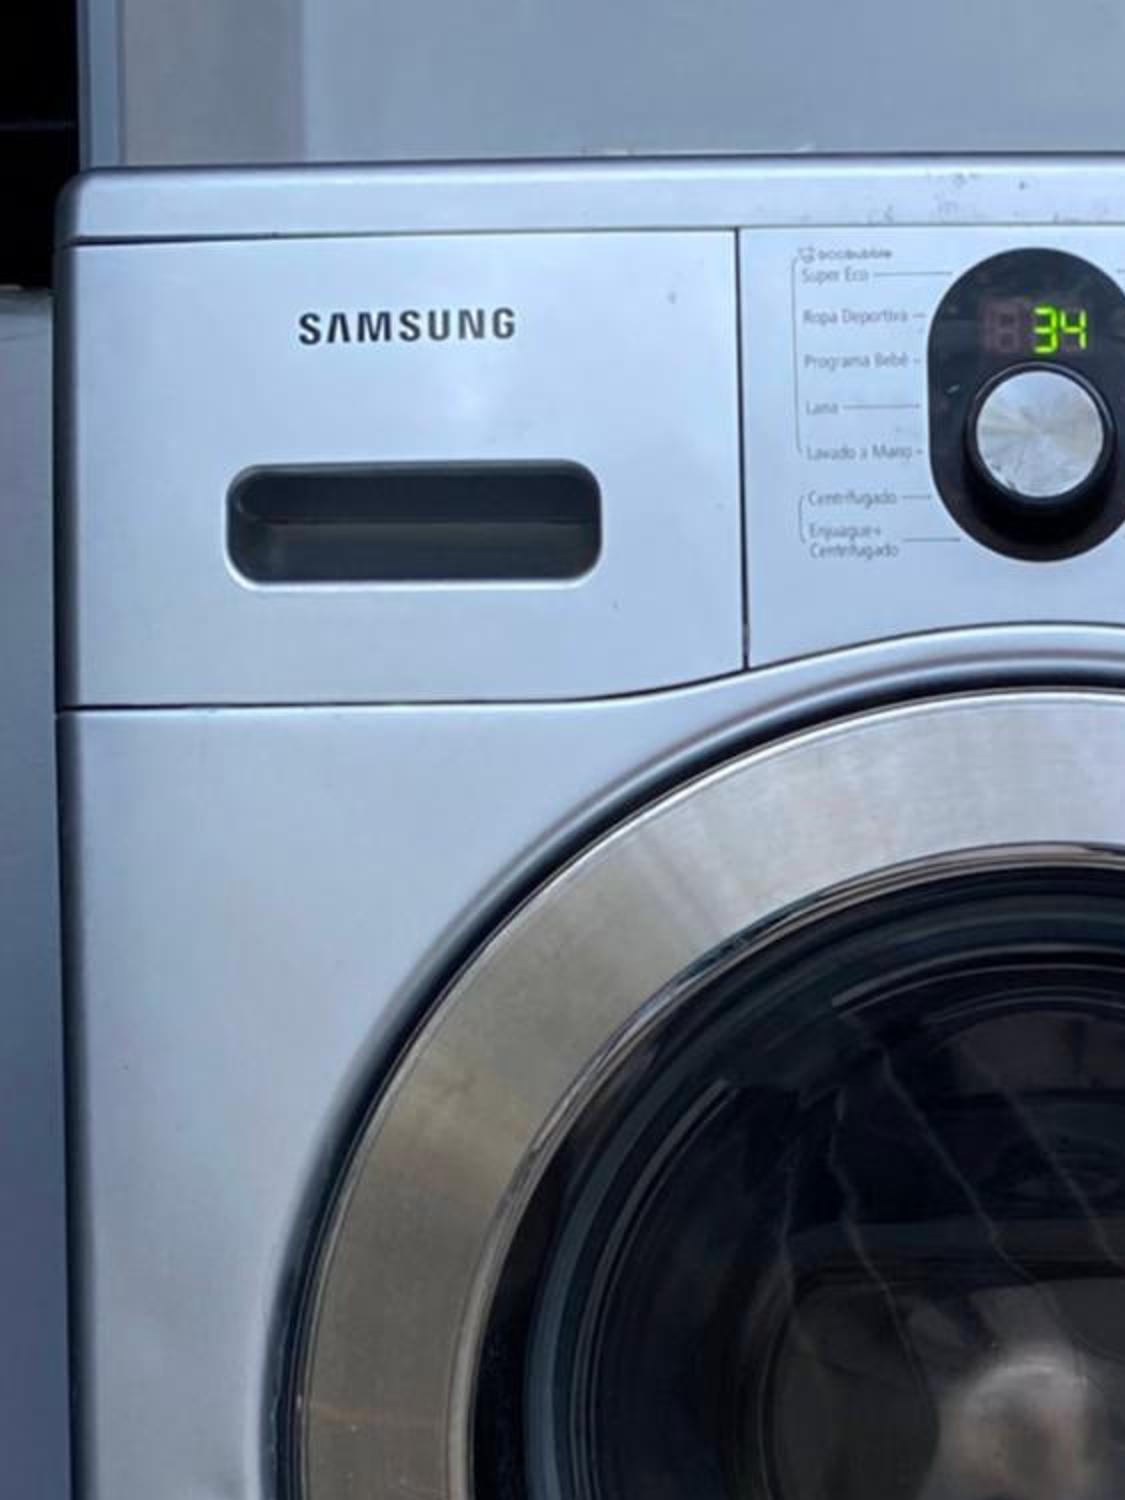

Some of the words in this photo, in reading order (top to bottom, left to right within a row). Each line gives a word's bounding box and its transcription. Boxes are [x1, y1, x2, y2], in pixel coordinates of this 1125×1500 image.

[801, 267, 840, 286] Super
[844, 265, 869, 282] Eco
[298, 307, 515, 346] SAMSUNG
[803, 309, 838, 327] Ropa
[841, 308, 909, 327] Deportiva
[1032, 304, 1088, 354] 34
[803, 354, 871, 373] Programa
[805, 400, 839, 416] Lana
[806, 444, 857, 460] Lavado
[860, 447, 868, 460] a
[872, 443, 912, 460] Mano
[808, 489, 898, 509] Centrifugado
[810, 543, 899, 561] Centrifugado
